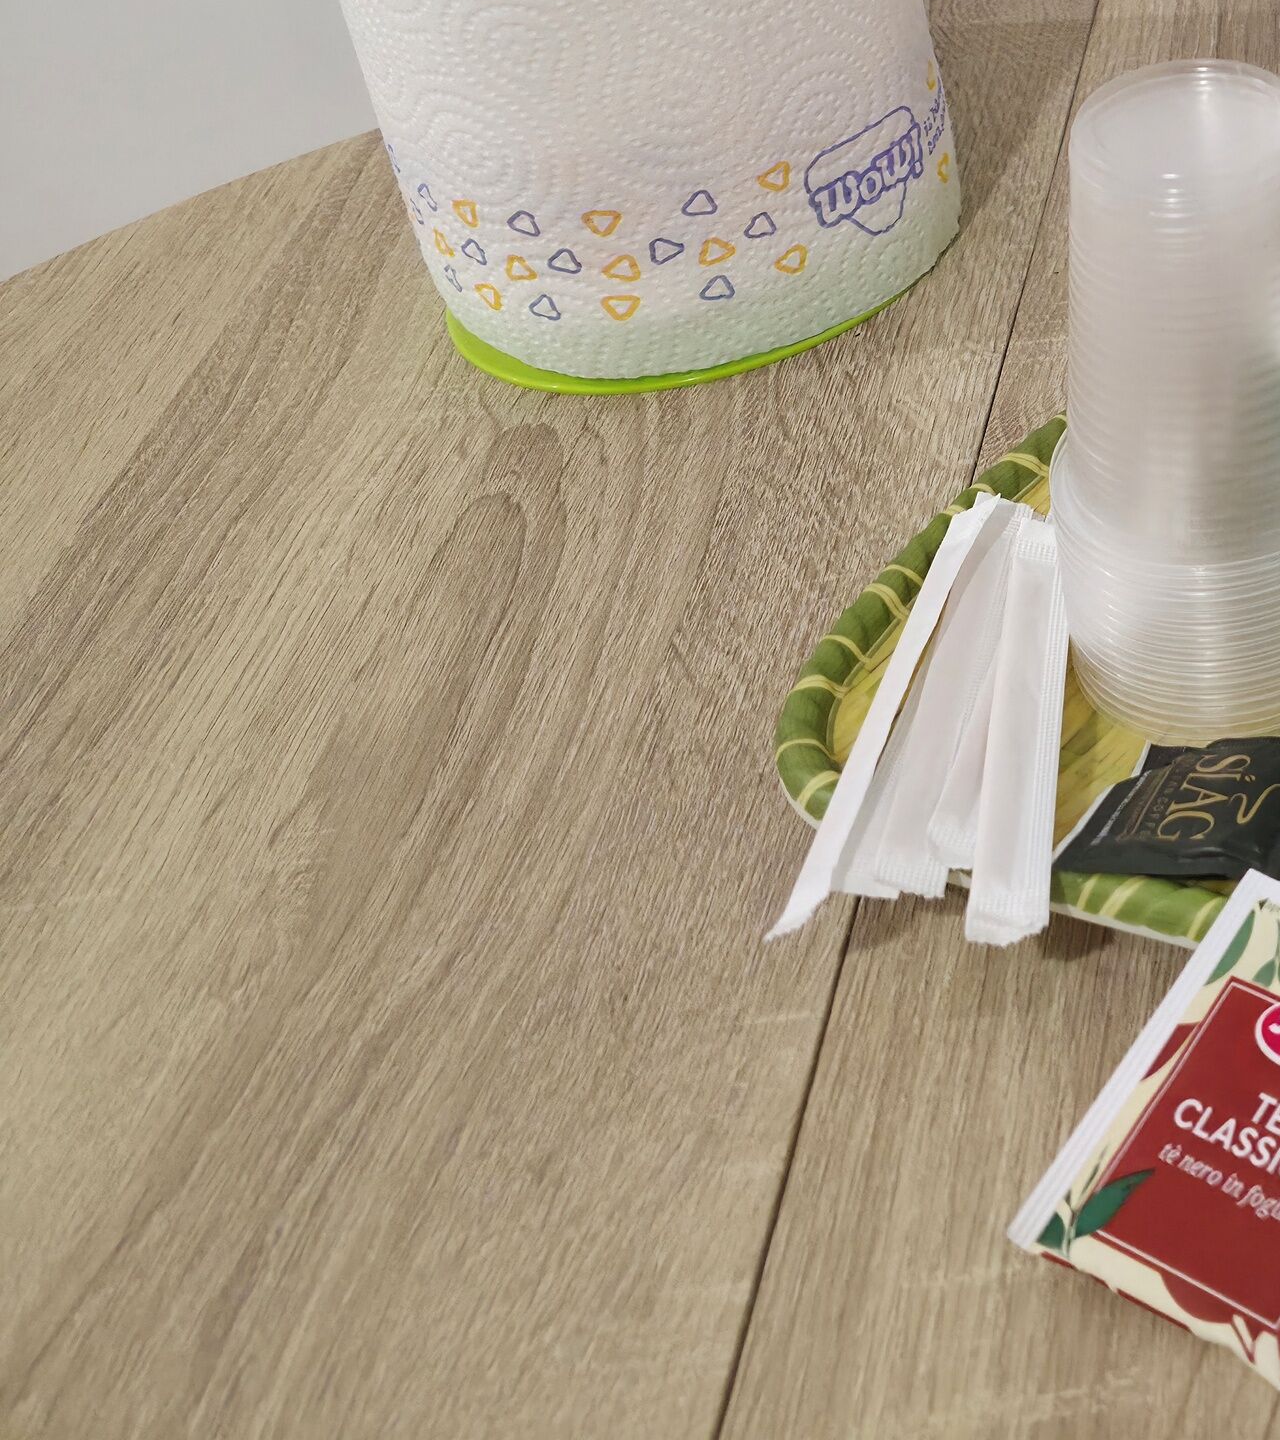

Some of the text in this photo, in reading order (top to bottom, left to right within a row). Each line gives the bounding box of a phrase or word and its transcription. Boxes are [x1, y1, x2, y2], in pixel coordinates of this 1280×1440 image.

[1158, 1143, 1182, 1165] tè
[1180, 1156, 1220, 1186] nero
[1219, 1172, 1242, 1197] in
